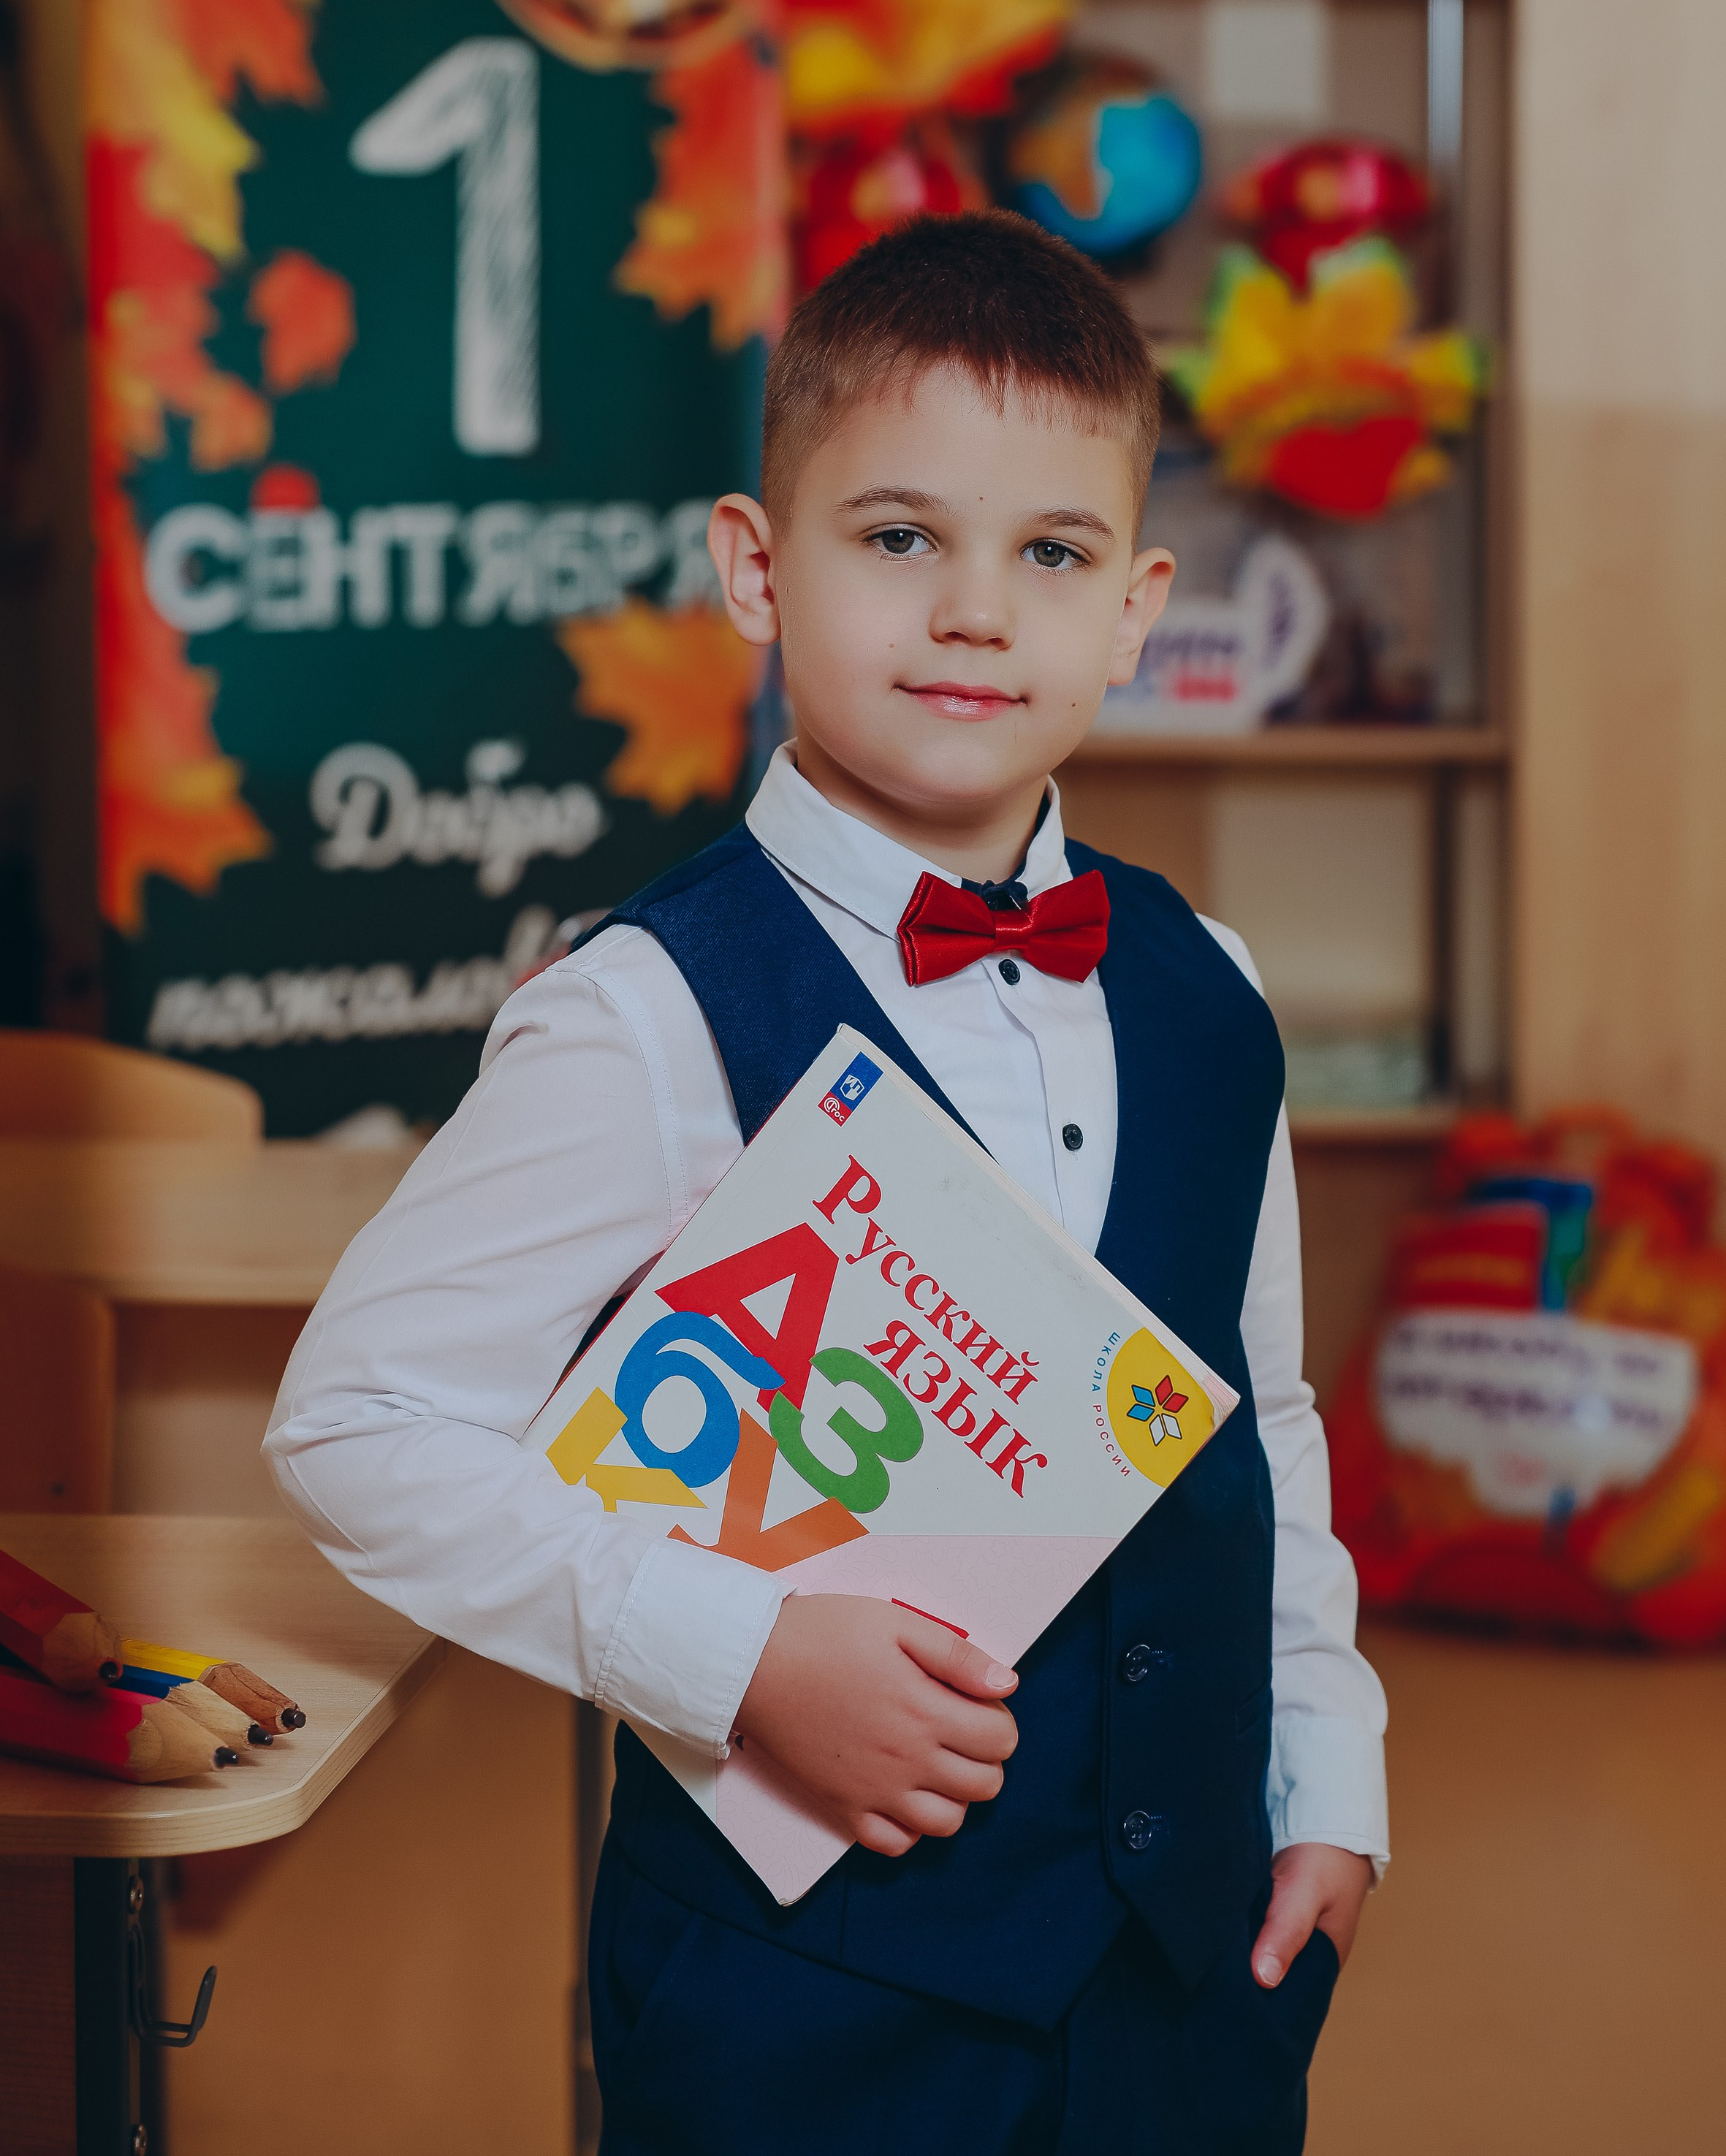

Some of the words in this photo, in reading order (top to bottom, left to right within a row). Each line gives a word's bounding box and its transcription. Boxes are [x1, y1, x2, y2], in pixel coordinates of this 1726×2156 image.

[349, 37, 539, 455] 1
[812, 1154, 1039, 1406] Русский
[1092, 1331, 1121, 1392] ШКОЛА
[1092, 1403, 1131, 1477] РОССИИ
